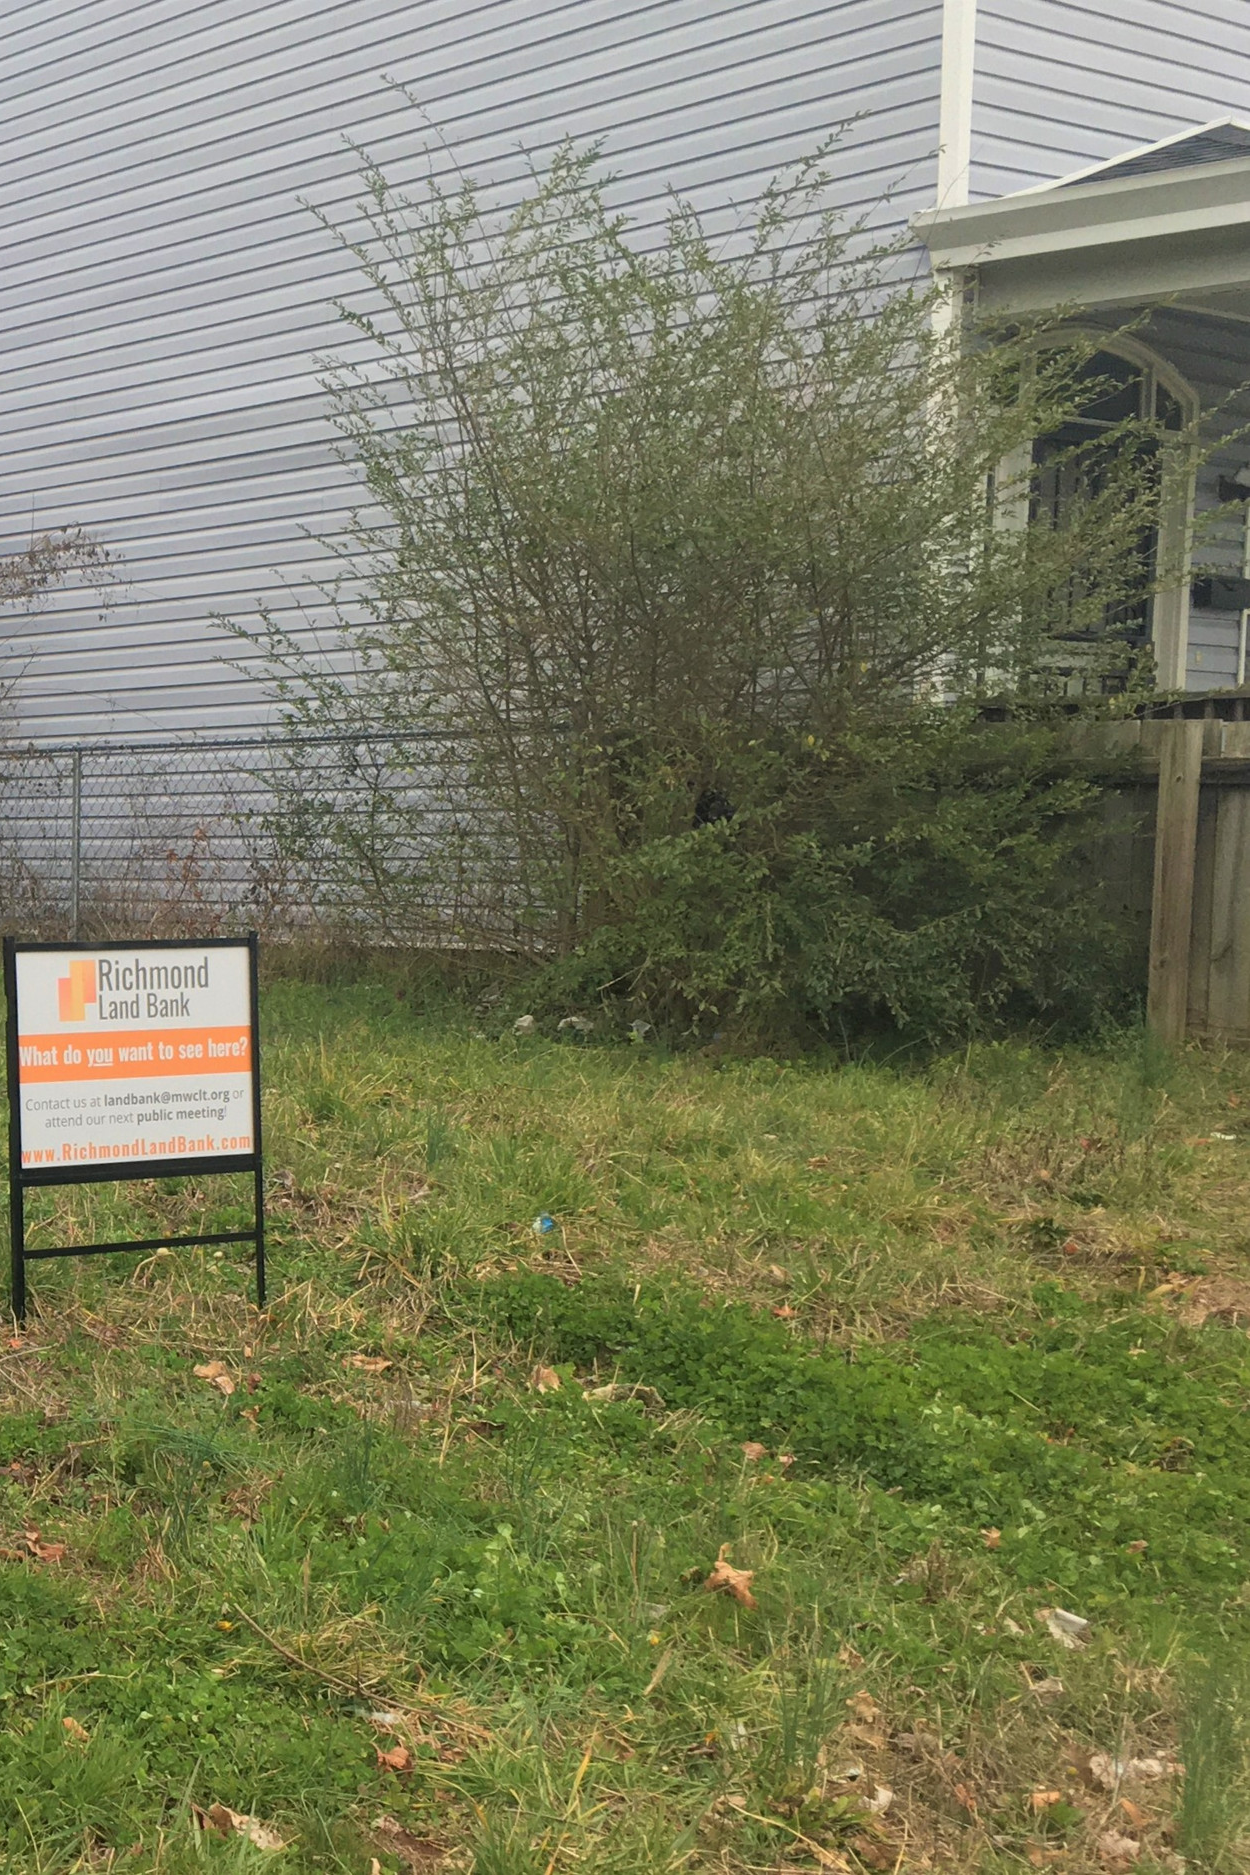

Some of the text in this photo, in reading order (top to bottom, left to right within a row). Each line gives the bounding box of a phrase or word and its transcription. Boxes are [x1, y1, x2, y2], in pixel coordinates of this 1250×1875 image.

[99, 957, 209, 991] Richmond
[99, 992, 190, 1020] Land Bank
[19, 1037, 248, 1067] What do you want to see here?
[26, 1089, 243, 1111] Contact us at landbank@mwclt.org or
[45, 1115, 82, 1128] attend
[87, 1116, 104, 1126] our
[109, 1114, 134, 1124] next
[137, 1109, 173, 1125] public
[22, 1135, 250, 1164] www.RichmondLandBank.com
